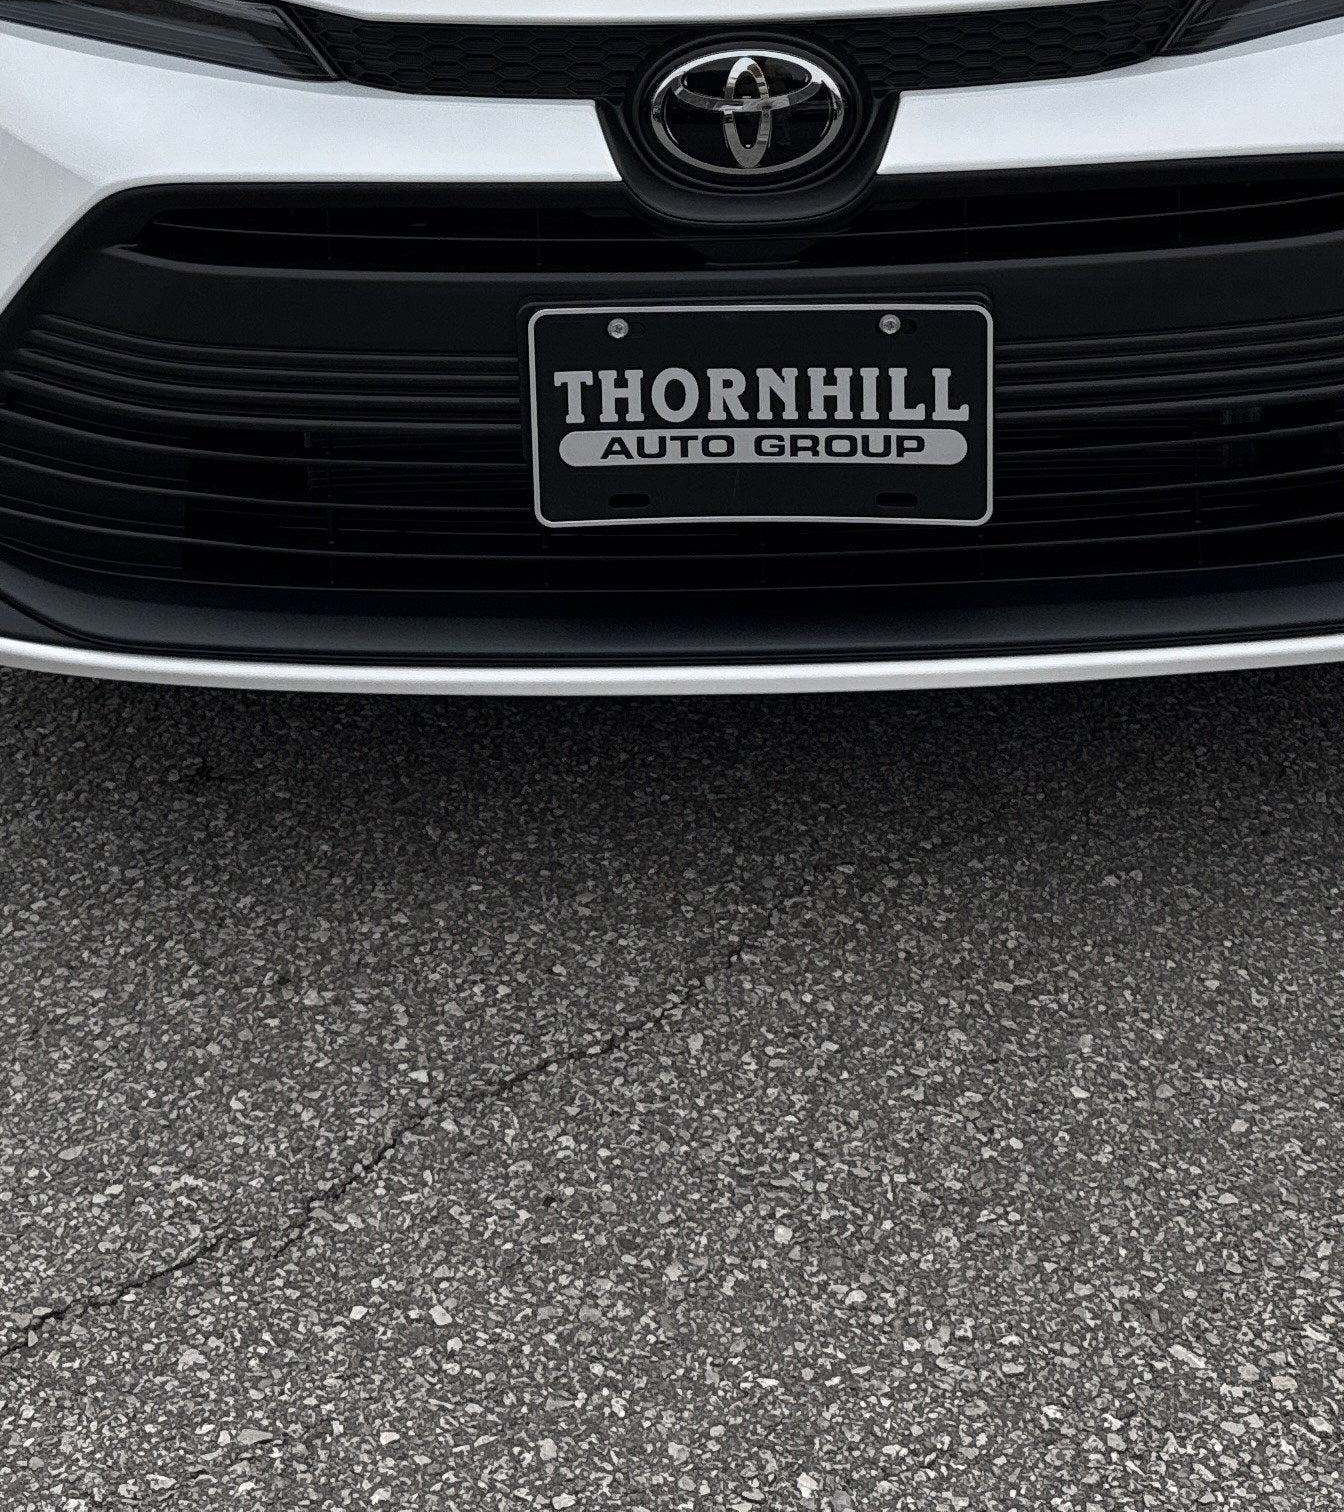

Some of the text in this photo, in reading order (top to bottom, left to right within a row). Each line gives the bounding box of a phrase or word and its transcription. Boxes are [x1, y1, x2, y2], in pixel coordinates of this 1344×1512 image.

[553, 367, 970, 424] THORNHILL
[600, 434, 925, 460] AUTO GROUP
